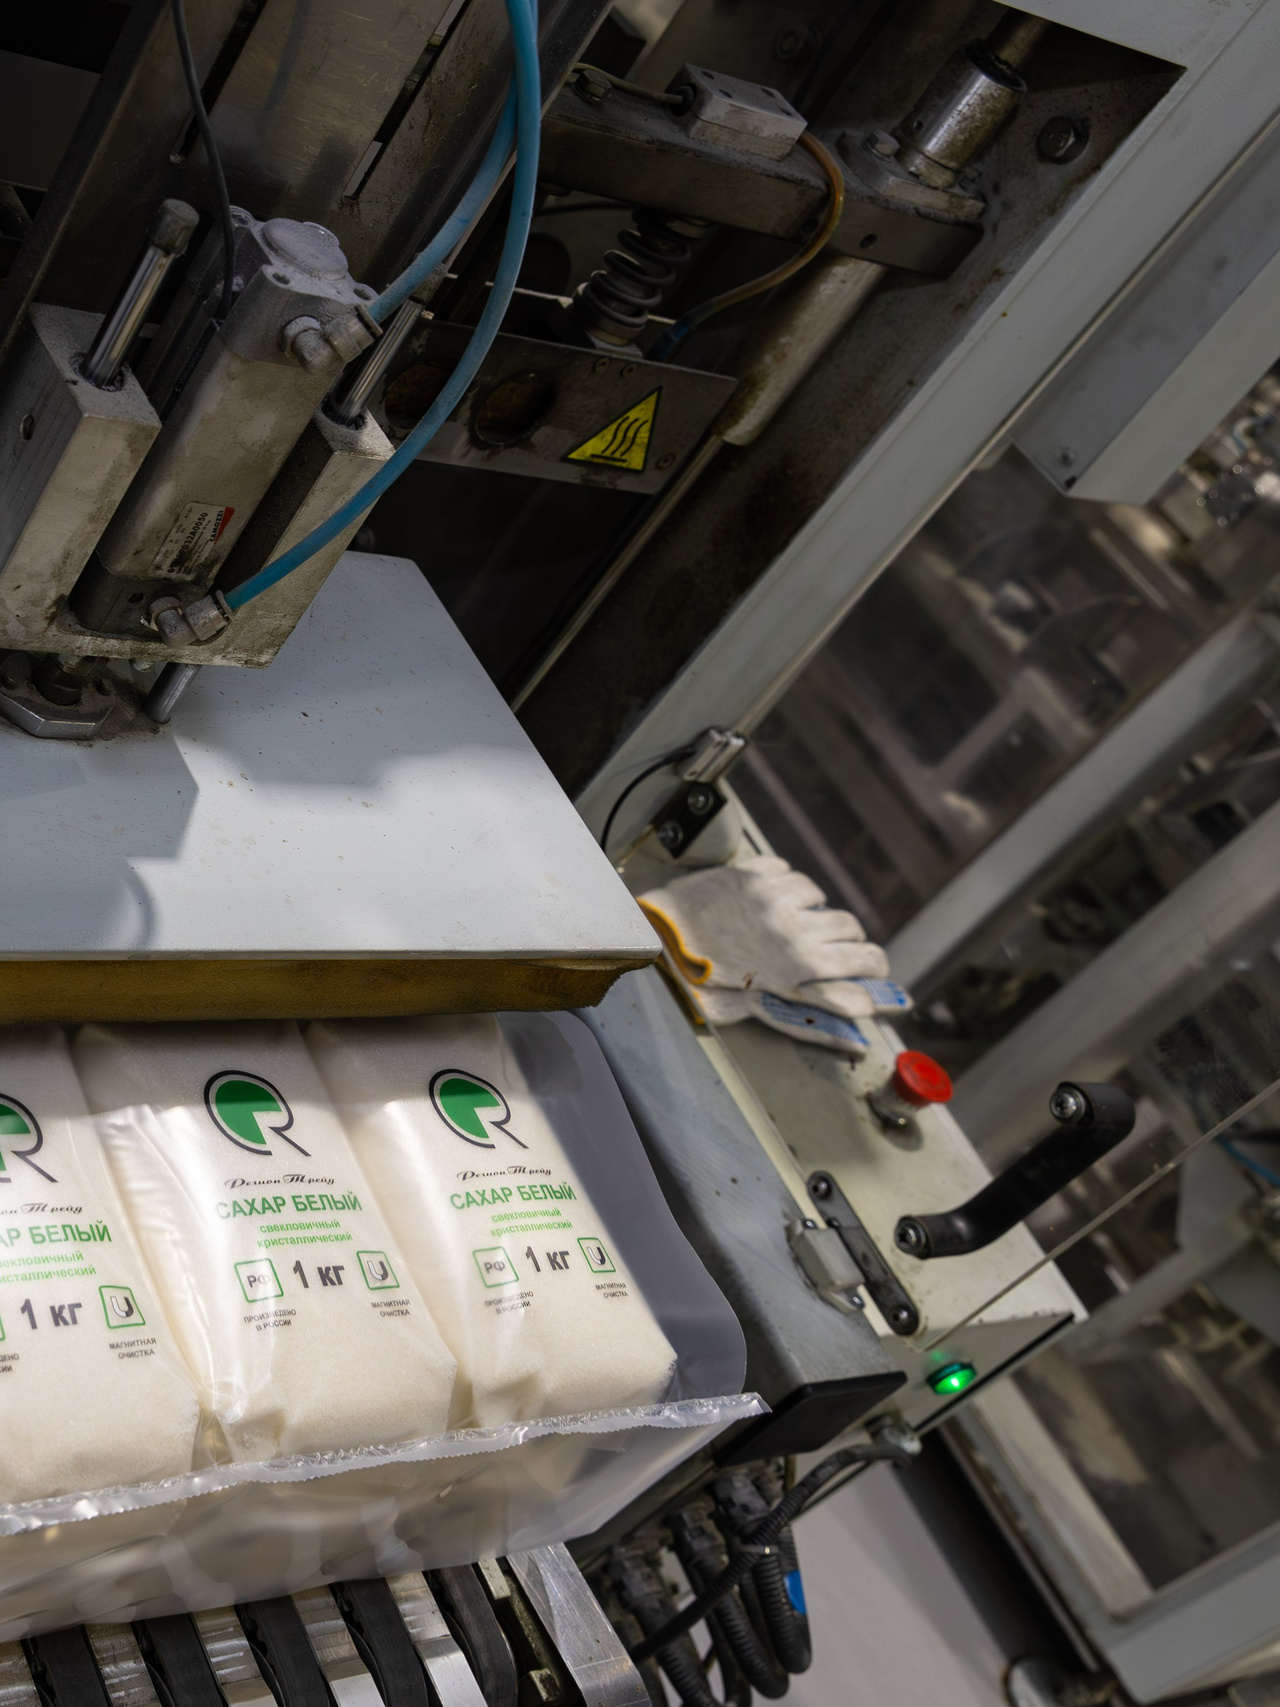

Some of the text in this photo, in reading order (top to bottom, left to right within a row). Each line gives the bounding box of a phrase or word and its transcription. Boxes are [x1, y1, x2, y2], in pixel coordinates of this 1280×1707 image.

[209, 510, 224, 542] CAMOZZI
[450, 1182, 577, 1210] САХАР БЕЛЫЙ
[216, 1190, 363, 1219] САХАР БЕЛЫЙ
[491, 1208, 561, 1223] свекловичный
[28, 1219, 112, 1245] БЕЛЫЙ
[259, 1218, 341, 1233] свекловичный
[490, 1220, 573, 1237] кристаллический
[257, 1231, 353, 1249] кристаллический
[525, 1246, 541, 1272] 1
[293, 1260, 309, 1289] 1
[484, 1260, 505, 1274] РФ
[246, 1273, 270, 1288] РФ
[595, 1283, 626, 1291] МАГНИТНАЯ
[603, 1291, 628, 1299] ОЧИСТКА
[371, 1299, 410, 1308] МАГНИТНАЯ
[502, 1301, 531, 1312] РОССИИ
[20, 1298, 38, 1330] 1
[379, 1309, 410, 1317] ОЧИСТКА
[263, 1319, 291, 1329] РОССИИ
[108, 1337, 157, 1350] МАГНИТНАЯ
[118, 1349, 155, 1359] ОЧИСТКА
